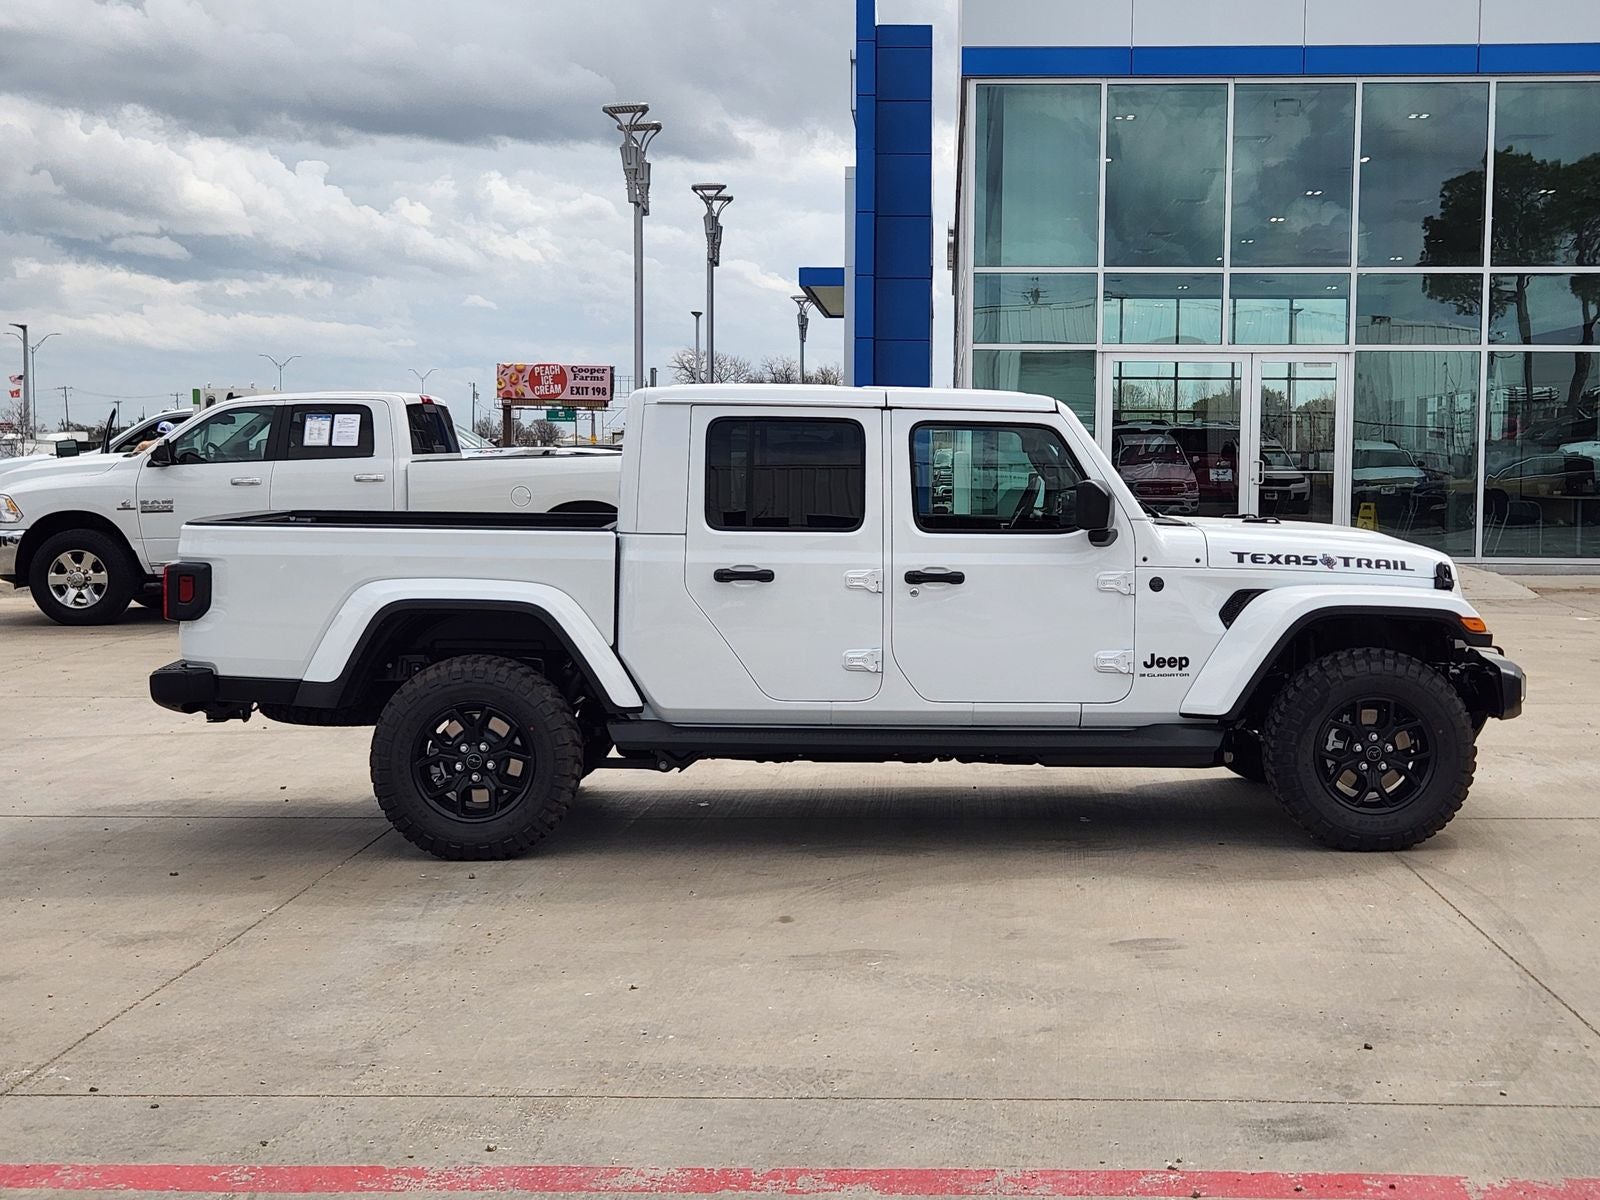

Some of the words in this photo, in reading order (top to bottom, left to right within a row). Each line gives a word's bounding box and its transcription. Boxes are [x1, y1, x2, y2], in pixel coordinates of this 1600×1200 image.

[534, 365, 561, 376] PEACH
[570, 366, 608, 375] Cooper
[541, 375, 554, 385] ICE
[573, 374, 605, 382] Farms
[534, 384, 562, 395] CREAM
[570, 386, 590, 396] EXIT
[591, 387, 607, 396] 198
[1229, 551, 1319, 566] TEXAS
[1336, 556, 1415, 571] TRAIL
[1143, 653, 1190, 671] Jeep
